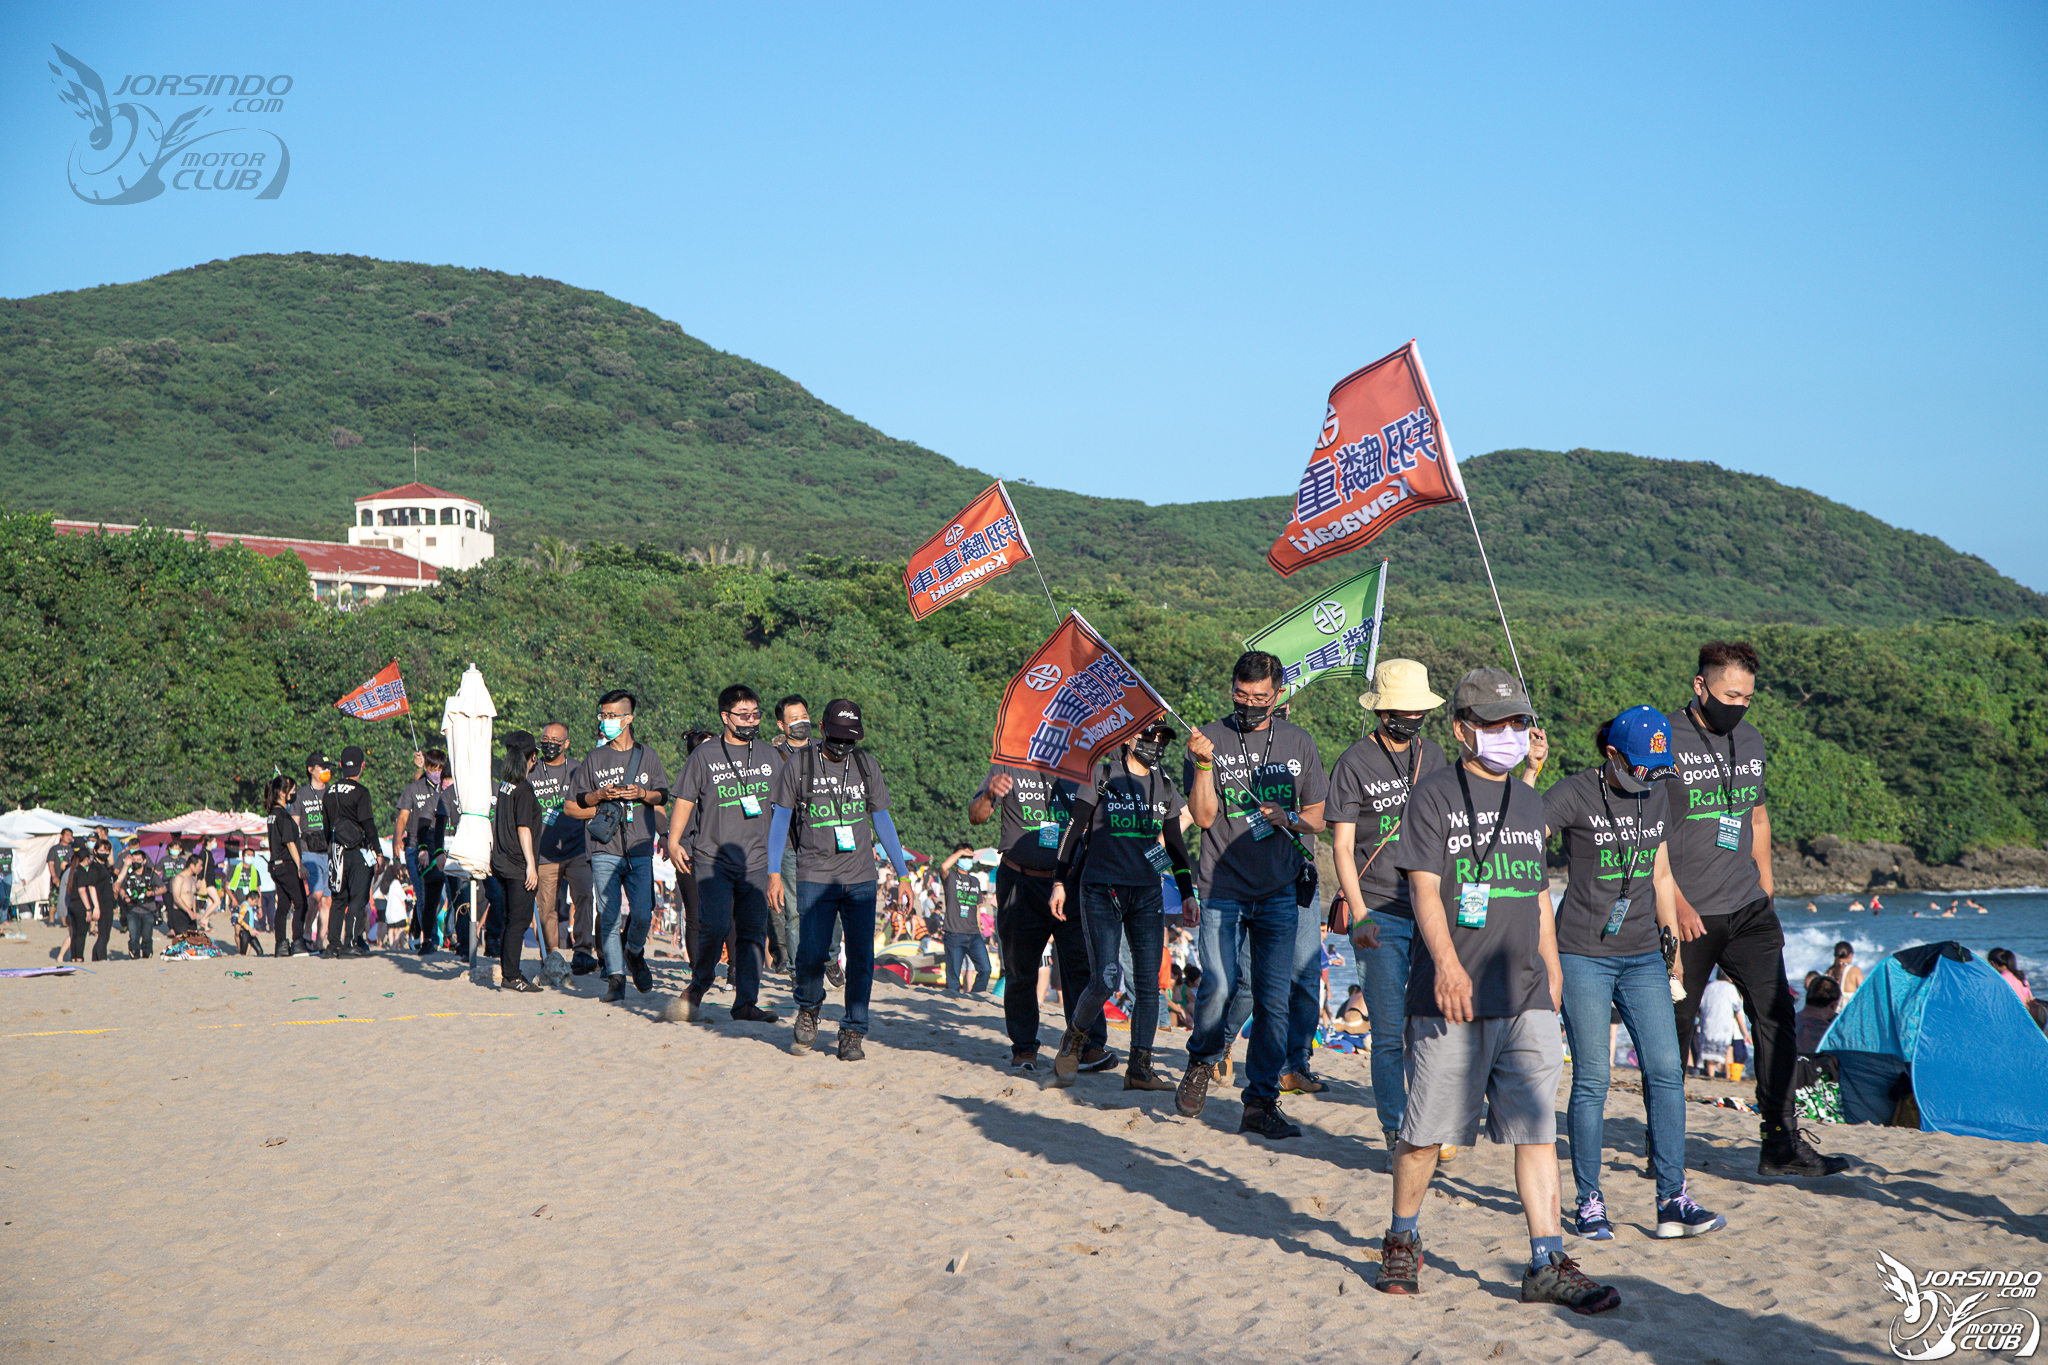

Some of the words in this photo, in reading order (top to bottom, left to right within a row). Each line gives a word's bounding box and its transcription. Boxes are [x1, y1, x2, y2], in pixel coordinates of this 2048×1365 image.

[1678, 752, 1702, 765] We
[595, 769, 609, 779] We
[609, 766, 625, 775] are
[708, 762, 726, 772] We
[738, 767, 761, 778] time
[1682, 764, 1720, 785] good
[1017, 778, 1036, 789] We
[1364, 780, 1390, 797] We
[1589, 815, 1611, 828] We
[1499, 827, 1535, 845] time
[1456, 853, 1542, 884] Rollers
